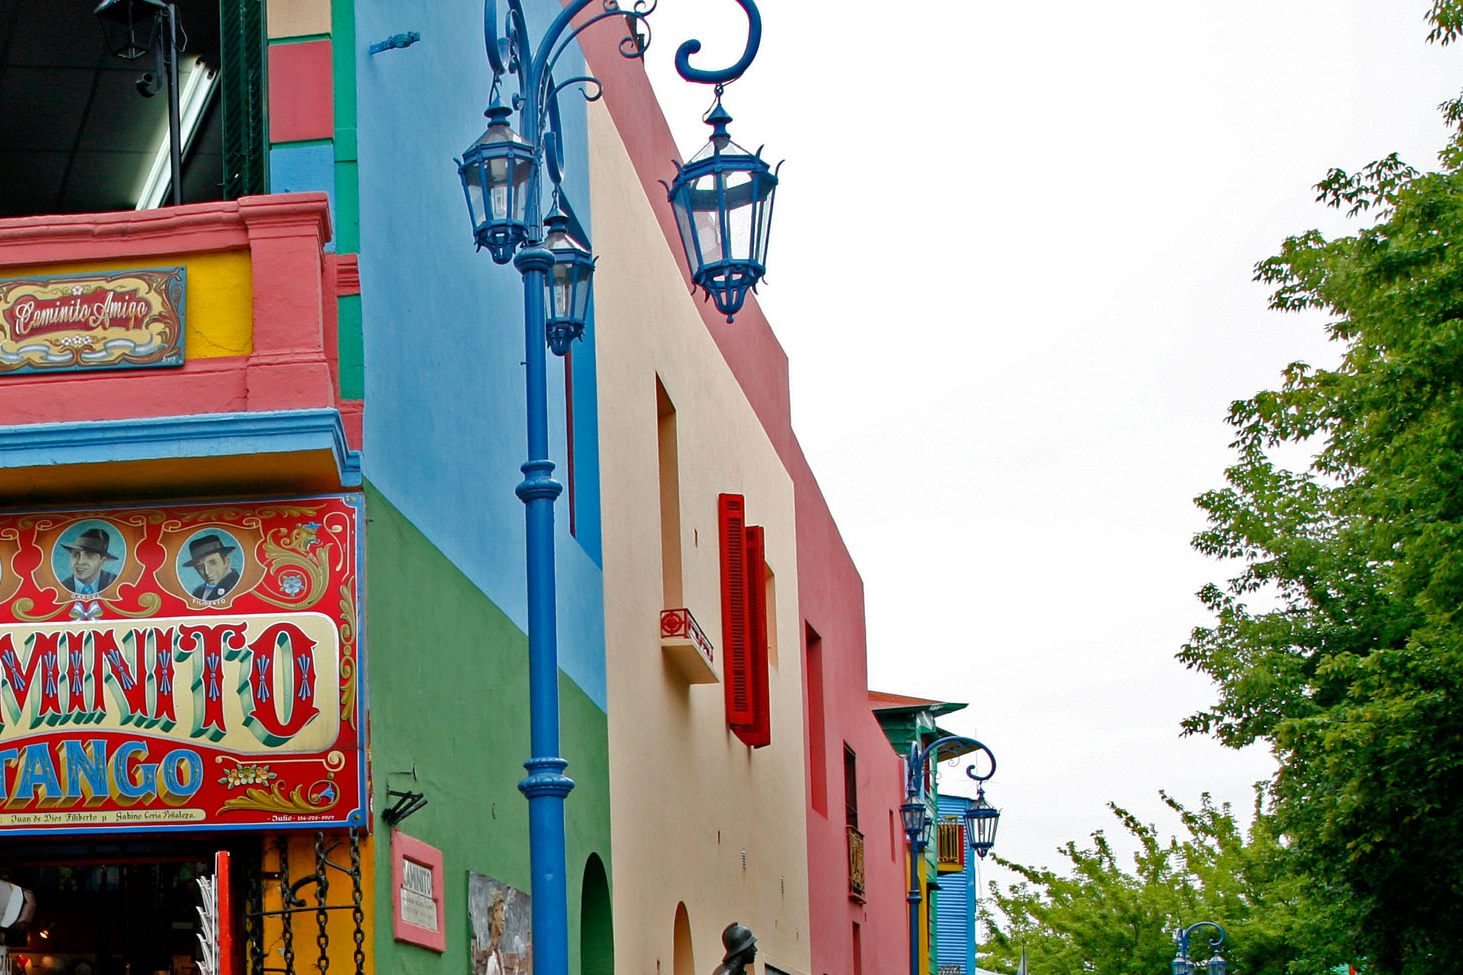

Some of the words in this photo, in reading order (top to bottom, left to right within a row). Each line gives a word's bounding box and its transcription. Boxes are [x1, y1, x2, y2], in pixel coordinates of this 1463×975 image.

[16, 299, 91, 334] Caminito
[90, 291, 147, 330] Amigo
[192, 598, 226, 606] FILIBERTO
[10, 815, 32, 825] Juan
[65, 813, 98, 822] Filiberto
[115, 811, 142, 822] Gabino
